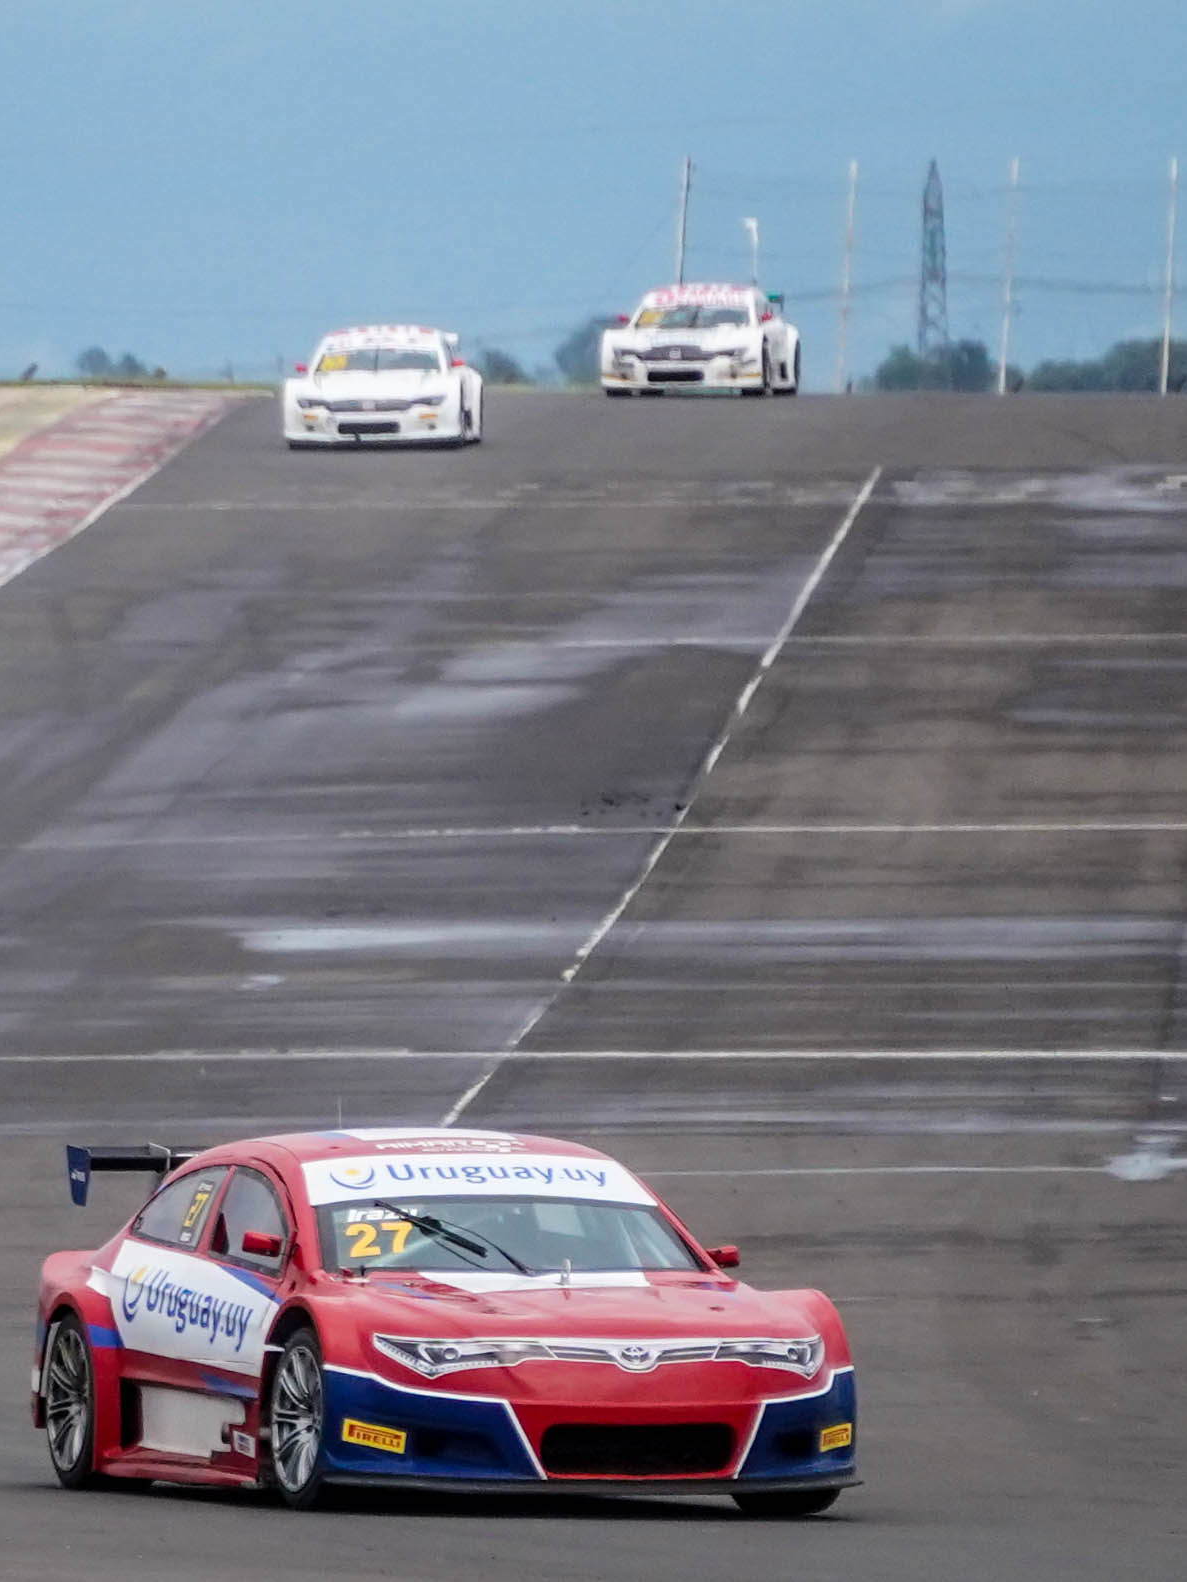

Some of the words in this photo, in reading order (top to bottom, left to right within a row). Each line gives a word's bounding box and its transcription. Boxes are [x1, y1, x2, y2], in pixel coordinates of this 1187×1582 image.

[386, 1163, 607, 1187] Uruguay.uy
[345, 1221, 414, 1258] 27
[147, 1269, 254, 1352] Uruguay.uy
[348, 1424, 402, 1448] PIRELLI
